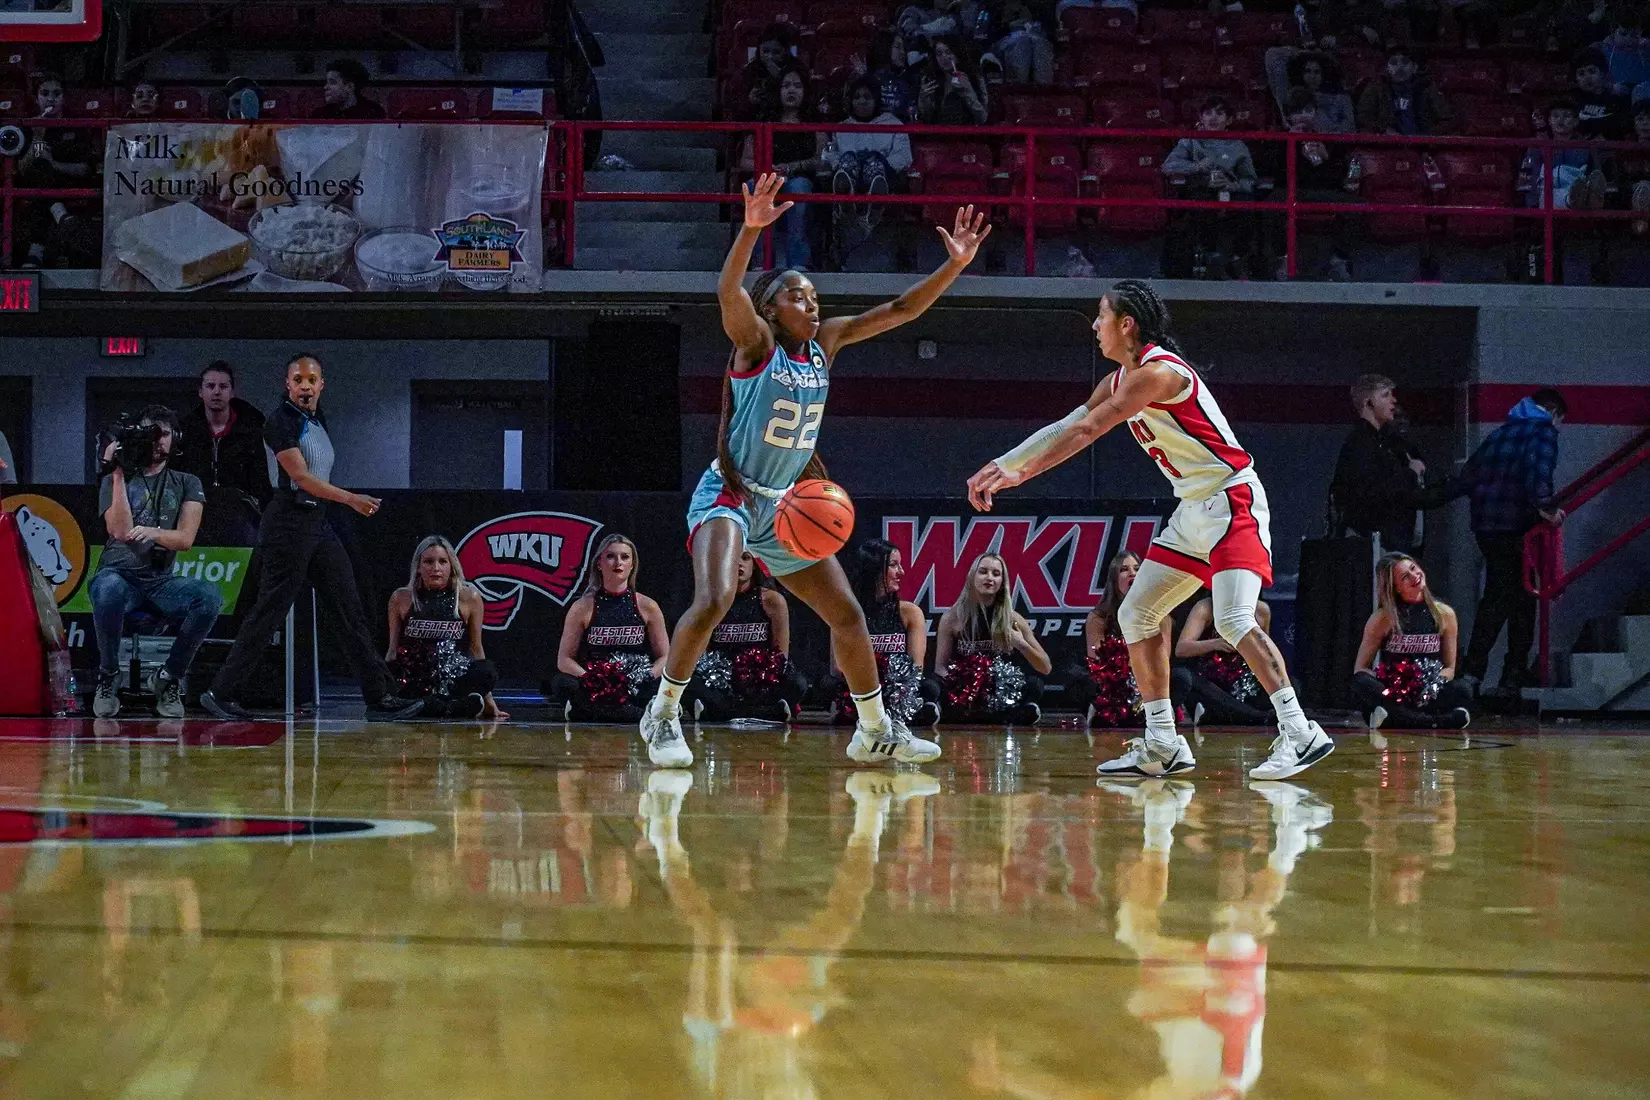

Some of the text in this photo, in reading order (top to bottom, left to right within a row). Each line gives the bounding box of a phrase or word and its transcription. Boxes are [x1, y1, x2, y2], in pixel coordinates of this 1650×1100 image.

[116, 135, 186, 160] Milk.
[114, 171, 365, 197] Natural Goodness
[445, 223, 513, 237] SOUTHLAND
[458, 258, 502, 266] FARMERS
[465, 251, 495, 259] DAIRY
[0, 279, 32, 310] XIT
[107, 336, 139, 355] EXIT
[763, 398, 825, 450] 22
[486, 532, 564, 569] WKU
[173, 553, 240, 582] rior
[882, 515, 1162, 613] WKU
[409, 619, 463, 630] WESTERN
[591, 625, 645, 636] WESTERN
[1391, 633, 1441, 644] WESTERN
